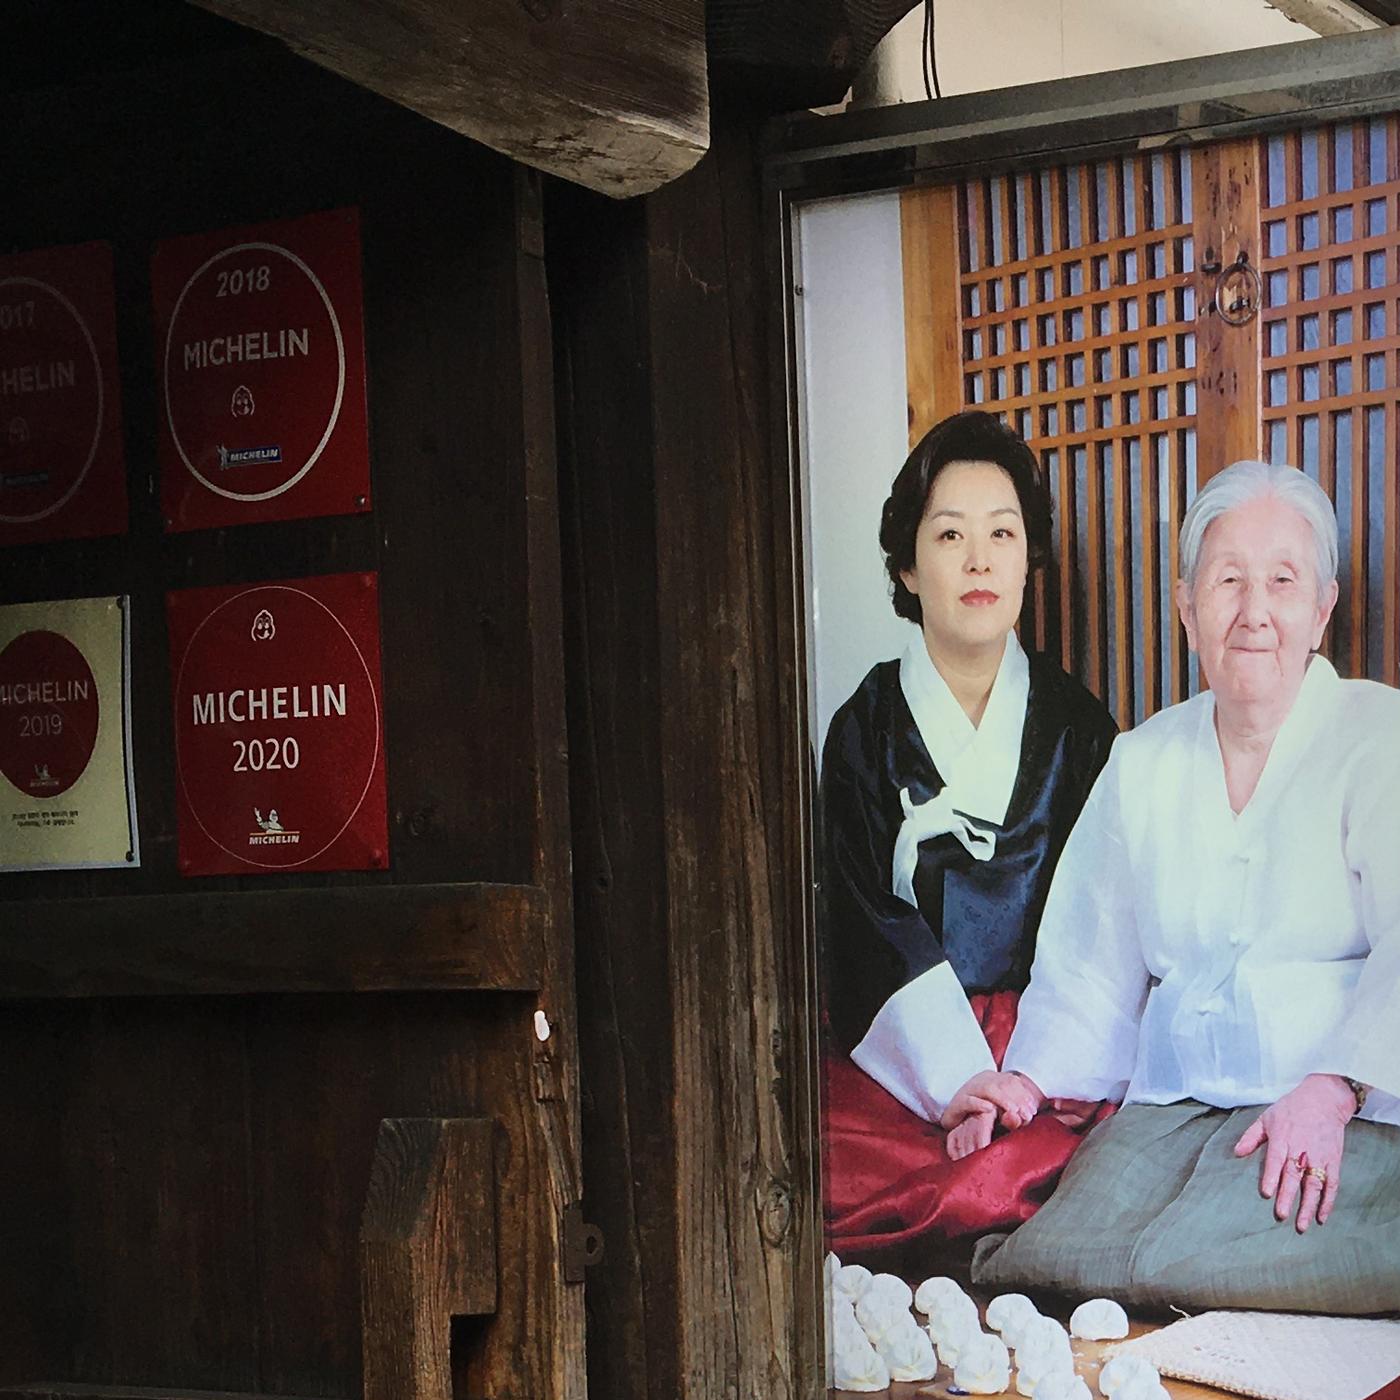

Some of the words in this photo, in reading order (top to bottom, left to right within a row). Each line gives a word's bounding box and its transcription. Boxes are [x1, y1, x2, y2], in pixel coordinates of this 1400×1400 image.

[215, 265, 271, 298] 2018
[0, 300, 35, 330] 017
[183, 327, 310, 371] MICHELIN
[0, 360, 75, 396] HELIN
[229, 448, 280, 463] MICHELIN
[192, 683, 347, 726] MICHELIN
[19, 713, 63, 738] 2019
[232, 736, 300, 772] 2020
[248, 834, 301, 846] MICHELIN
